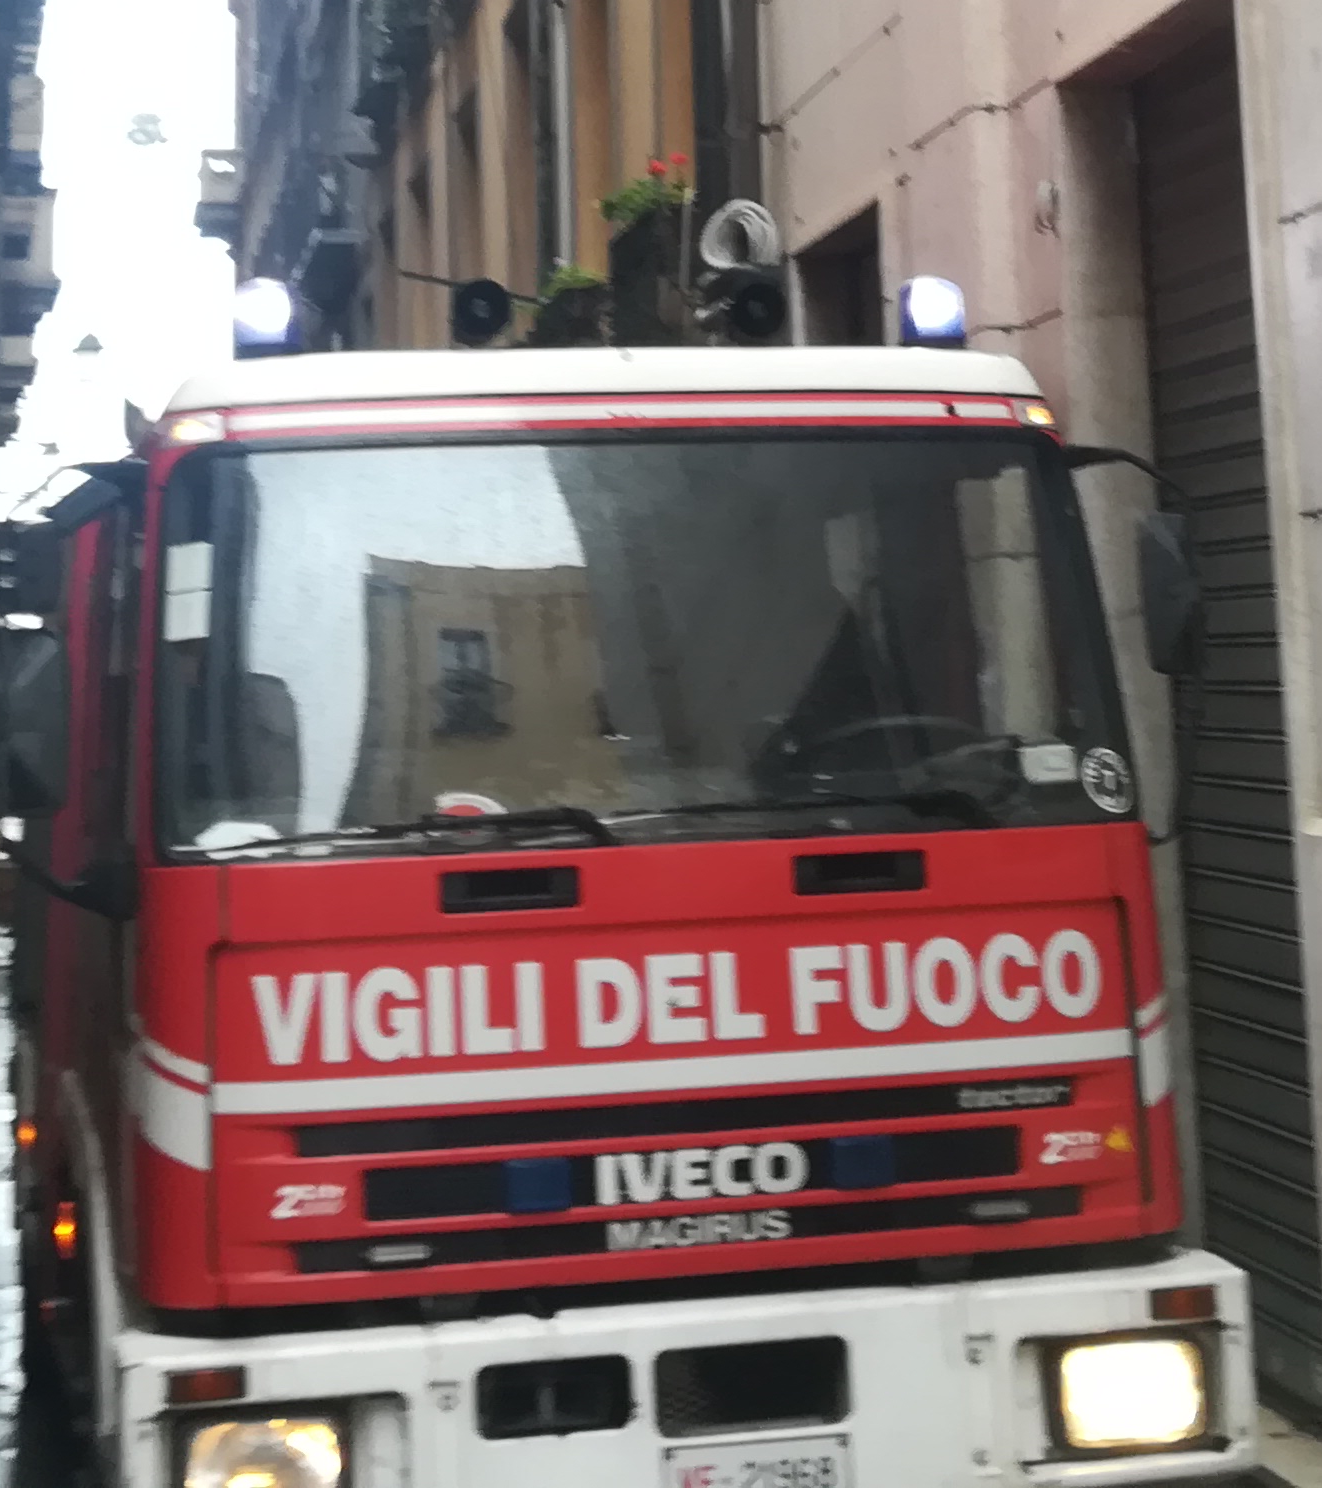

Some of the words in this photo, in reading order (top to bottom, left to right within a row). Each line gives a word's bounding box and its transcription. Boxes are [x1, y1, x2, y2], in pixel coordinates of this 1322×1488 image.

[248, 960, 547, 1066] VIGILI
[574, 949, 767, 1049] DEL
[788, 928, 1103, 1037] FUOCO
[594, 1141, 811, 1206] IVECO
[605, 1209, 795, 1252] MAGIRUS
